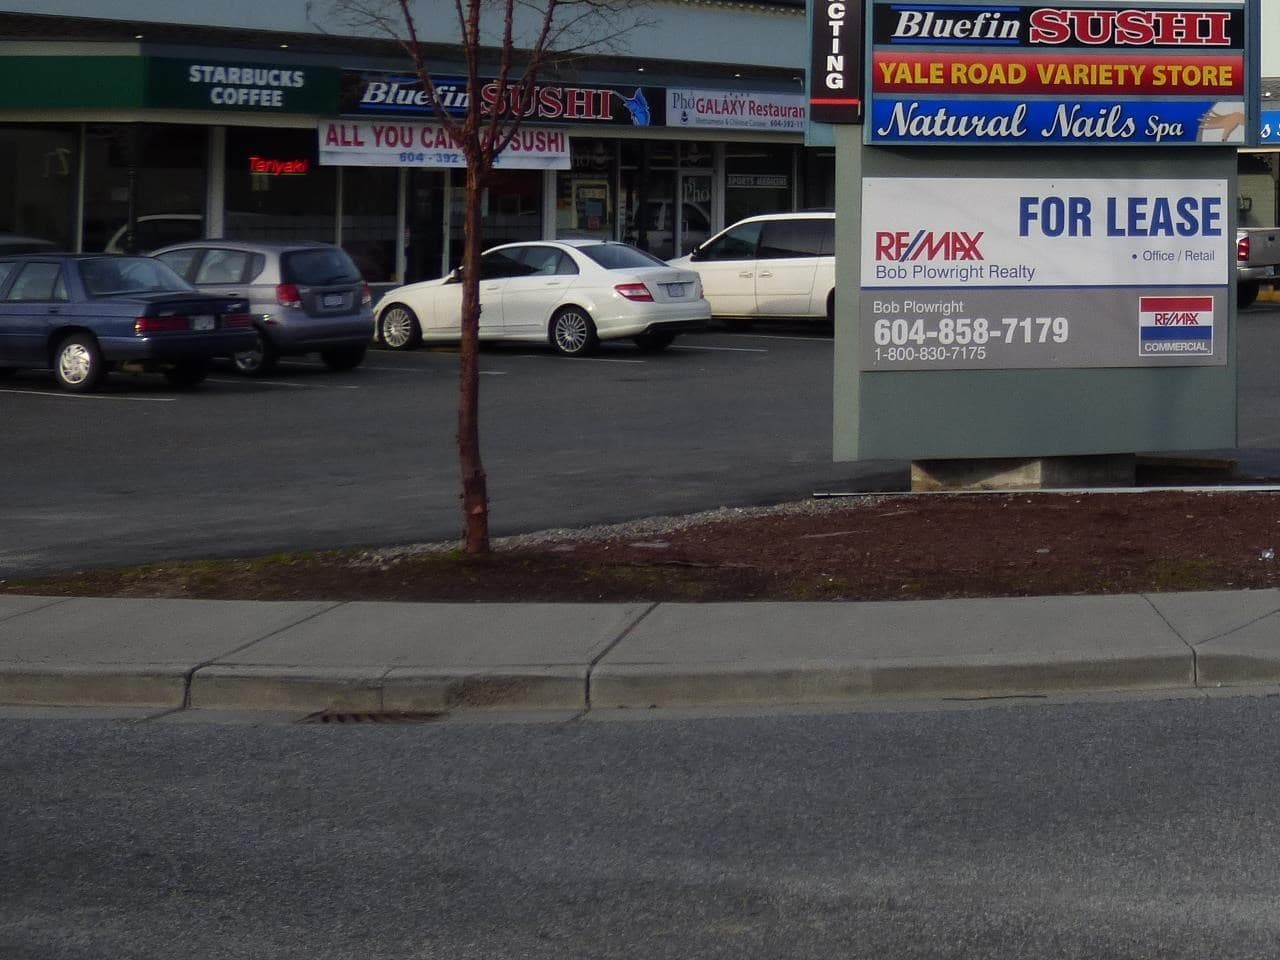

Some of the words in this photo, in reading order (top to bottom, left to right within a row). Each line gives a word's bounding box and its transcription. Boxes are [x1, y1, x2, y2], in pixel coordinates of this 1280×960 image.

[891, 10, 1020, 39] Bluefin
[1029, 8, 1231, 46] SUSHI
[189, 65, 304, 87] STARBUCKS
[879, 62, 944, 84] YALE
[951, 63, 1026, 85] ROAD
[1036, 64, 1146, 86] VARIETY
[1152, 64, 1233, 87] STORE
[210, 87, 284, 107] COFFEE
[696, 97, 746, 116] GALAXY
[748, 100, 805, 118] Restauran
[877, 101, 1027, 138] Natural
[1041, 104, 1136, 138] Nails
[1144, 115, 1184, 142] Spa
[326, 124, 364, 147] ALL
[371, 126, 413, 148] YOU
[510, 131, 565, 152] SUSHI
[400, 152, 424, 162] 604
[436, 154, 459, 163] 392
[1019, 196, 1092, 237] FOR
[1107, 197, 1222, 237] LEASE
[875, 229, 985, 262] RE/MAX
[1142, 250, 1175, 261] Office
[1185, 250, 1215, 261] Retail
[876, 265, 907, 279] Bob
[912, 265, 984, 282] Plowright
[989, 264, 1036, 282] Realty
[873, 301, 900, 314] Bob
[903, 300, 965, 316] Plowright
[1154, 312, 1199, 327] RE/MAX
[873, 317, 1070, 346] 604-858-7179
[875, 347, 987, 361] 1-800-830-7175
[1144, 342, 1209, 352] COMMERCIAL
